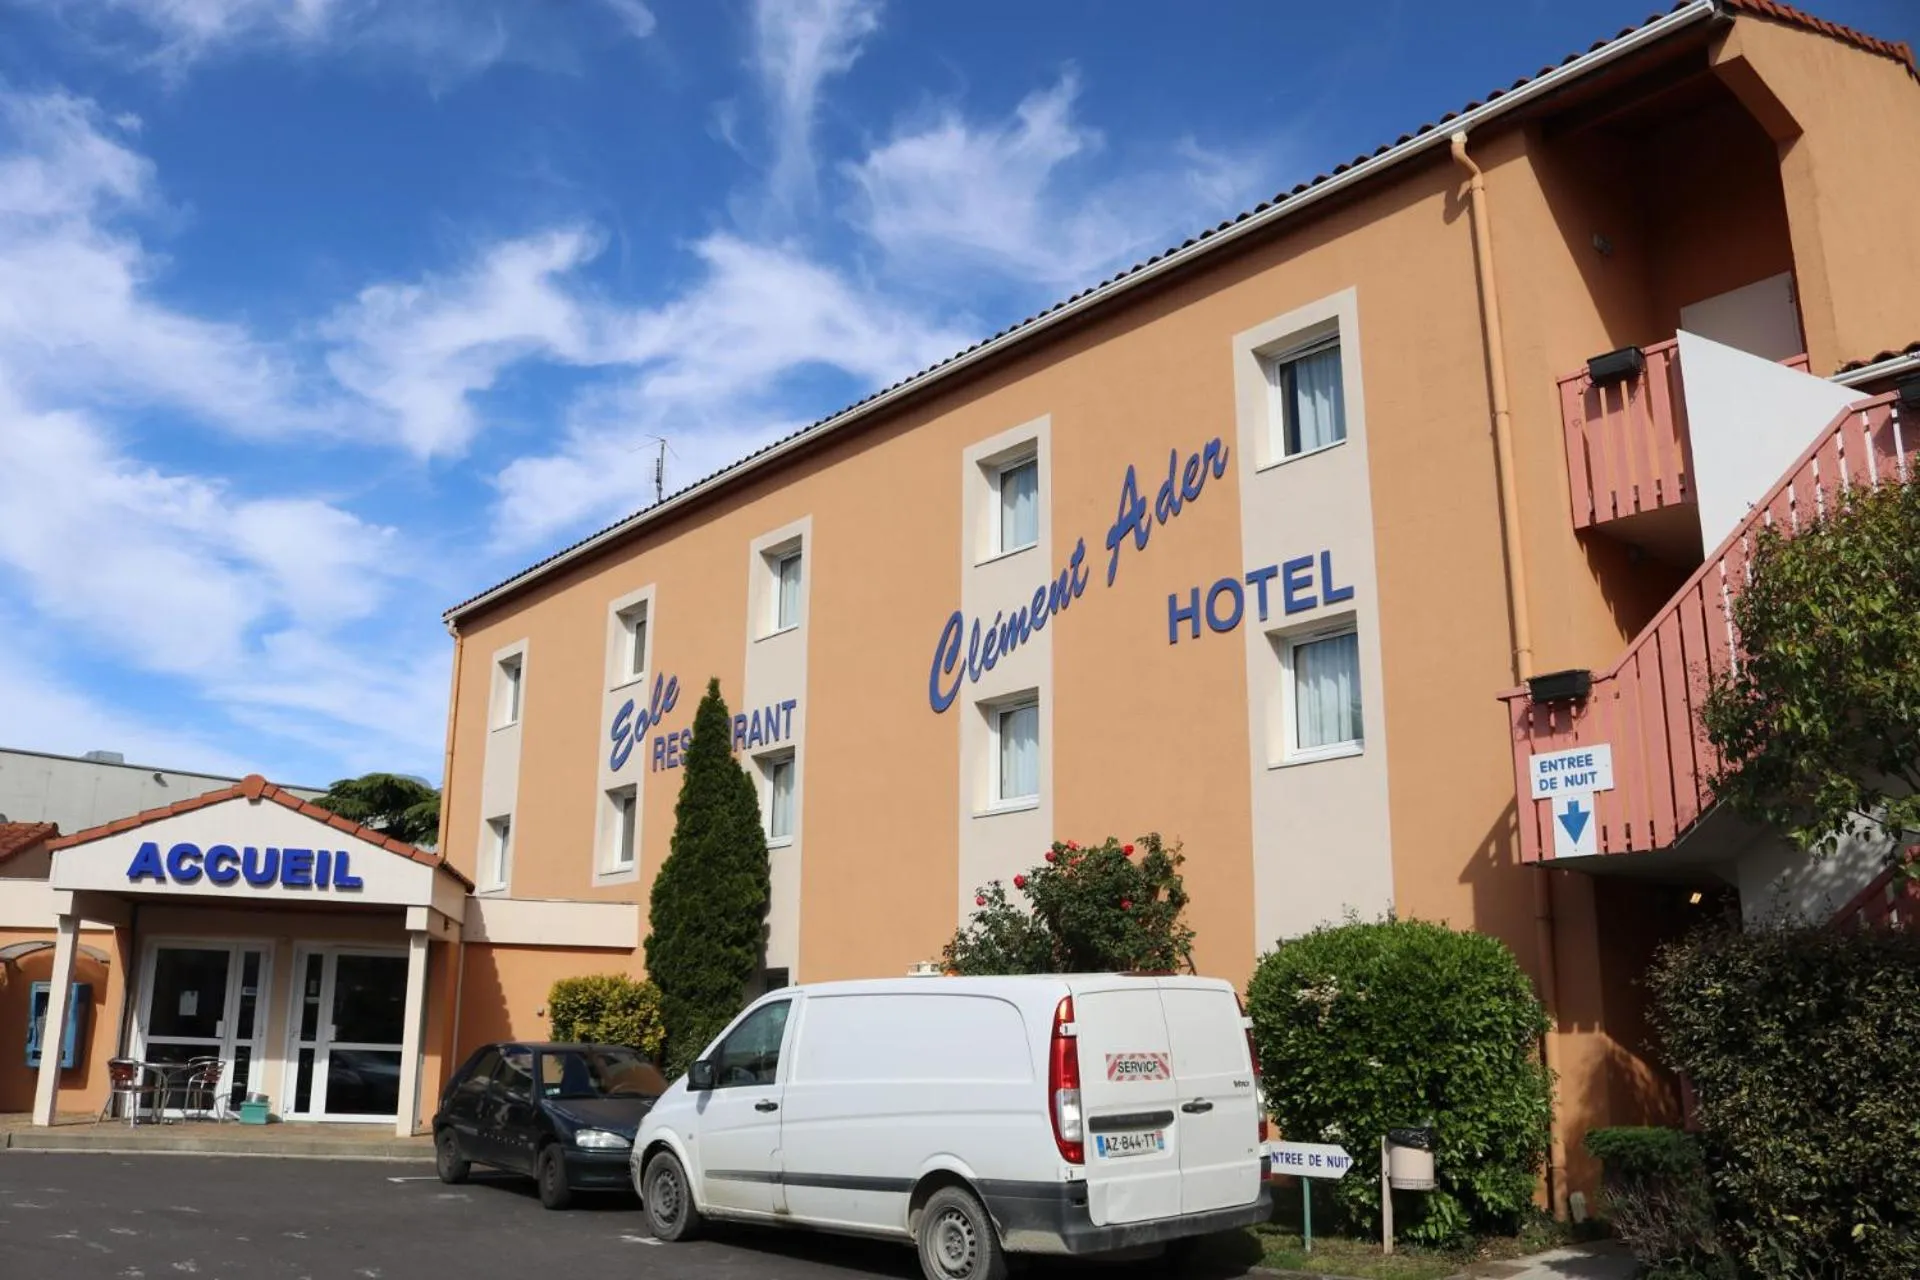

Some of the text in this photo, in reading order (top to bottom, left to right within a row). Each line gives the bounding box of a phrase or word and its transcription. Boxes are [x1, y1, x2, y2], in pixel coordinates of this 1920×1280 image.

[929, 437, 1229, 713] Clément Ader
[1168, 550, 1354, 645] HOTEL
[610, 671, 680, 772] Eole
[652, 699, 796, 772] RESRANT
[1539, 771, 1597, 791] DE NUIT
[1540, 753, 1594, 773] ENTREE
[126, 842, 363, 890] ACCUEIL
[1271, 1151, 1350, 1169] NTREE DE NUIT
